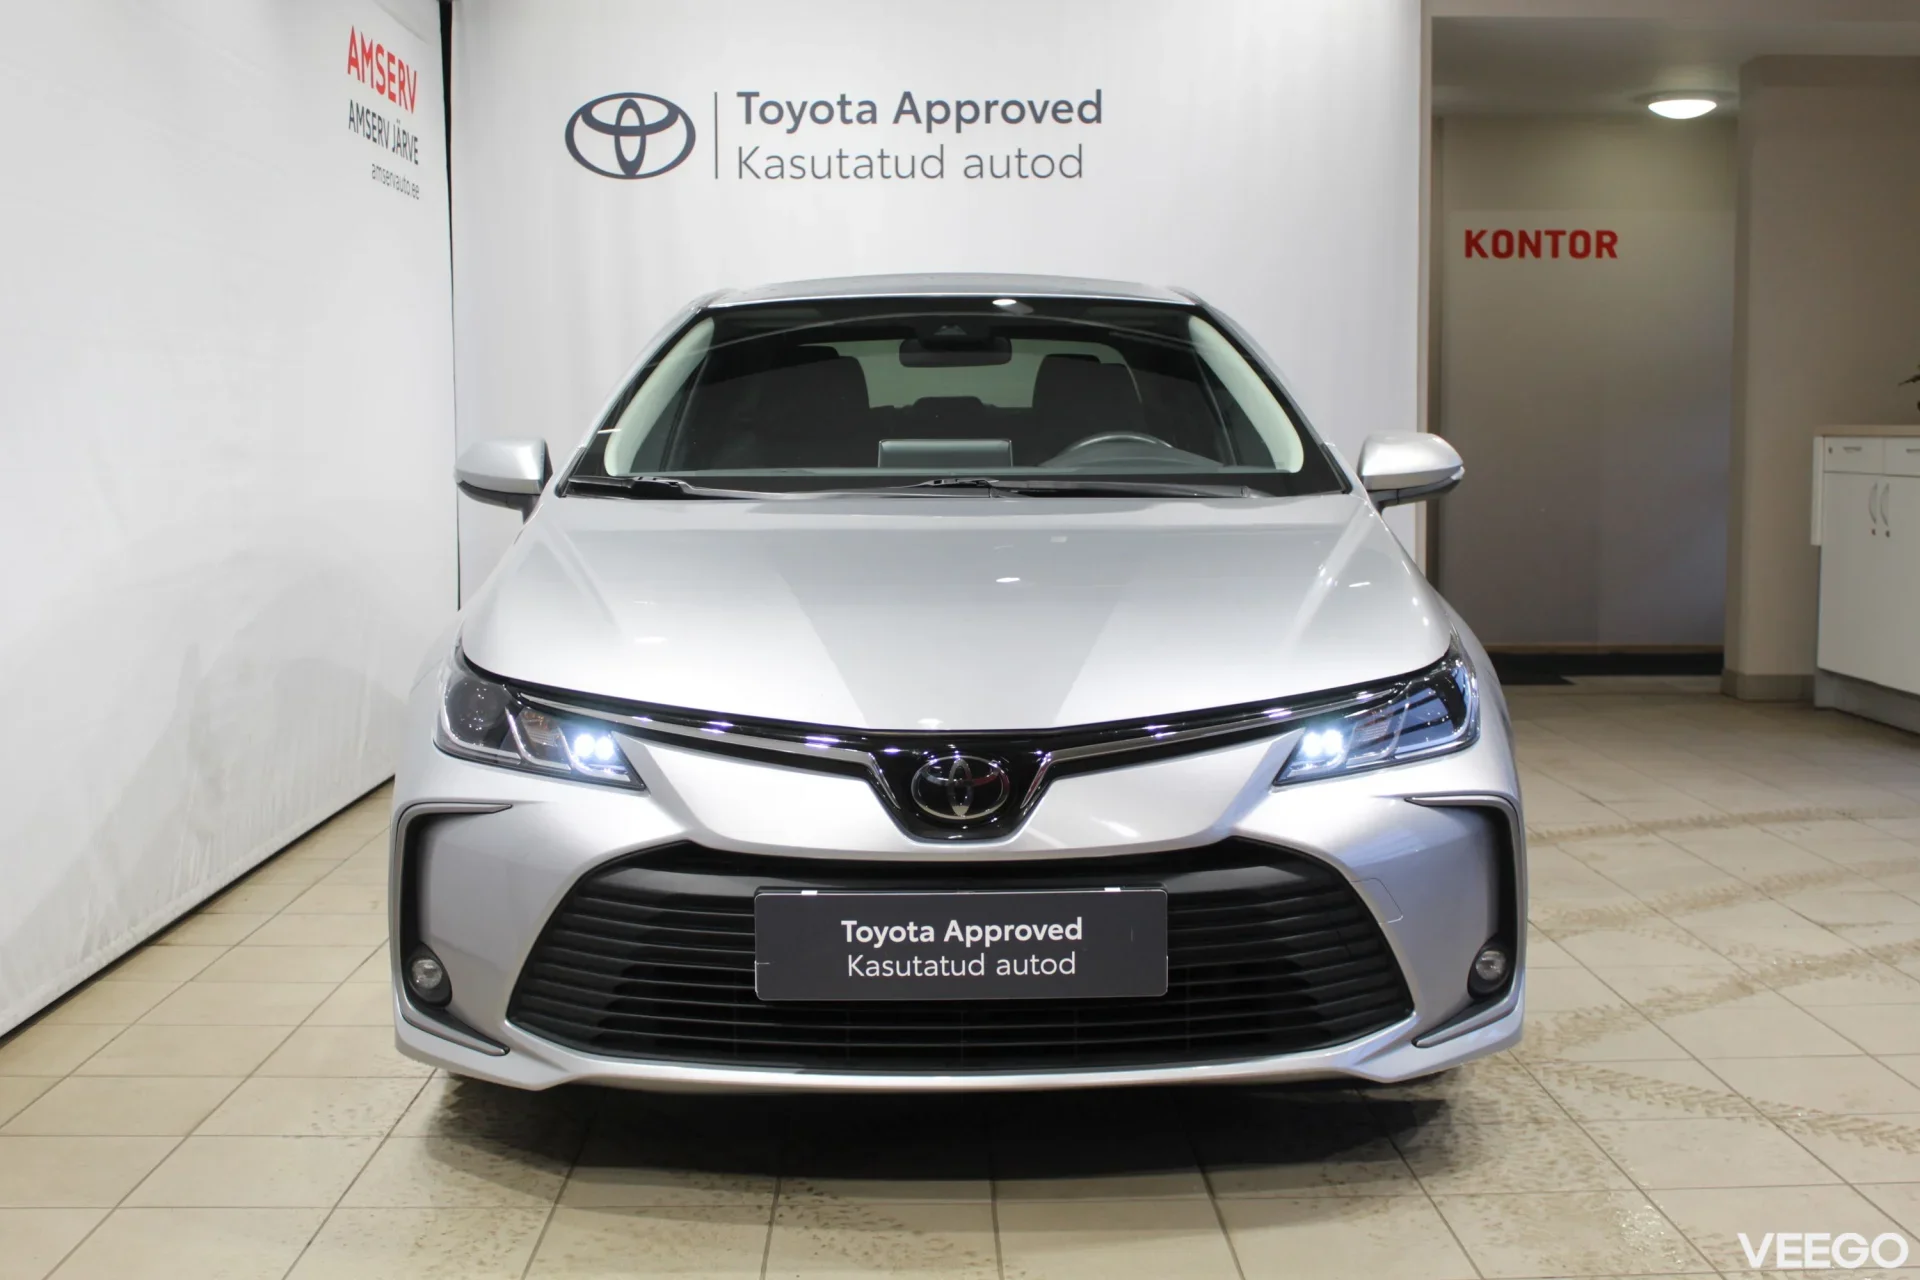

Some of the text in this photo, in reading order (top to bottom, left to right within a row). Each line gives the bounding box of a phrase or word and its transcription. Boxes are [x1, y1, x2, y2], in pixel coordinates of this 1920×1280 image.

[347, 25, 417, 114] AMSERV
[737, 89, 1102, 134] Toyota Approved
[348, 99, 419, 165] AMSERV JÄRVE
[738, 143, 1083, 180] Kasutatud autod
[371, 163, 420, 200] amservauto.ee
[1464, 229, 1618, 259] KONTOR
[841, 917, 1082, 948] Toyota Approved
[847, 951, 1076, 977] Kasutatud autod
